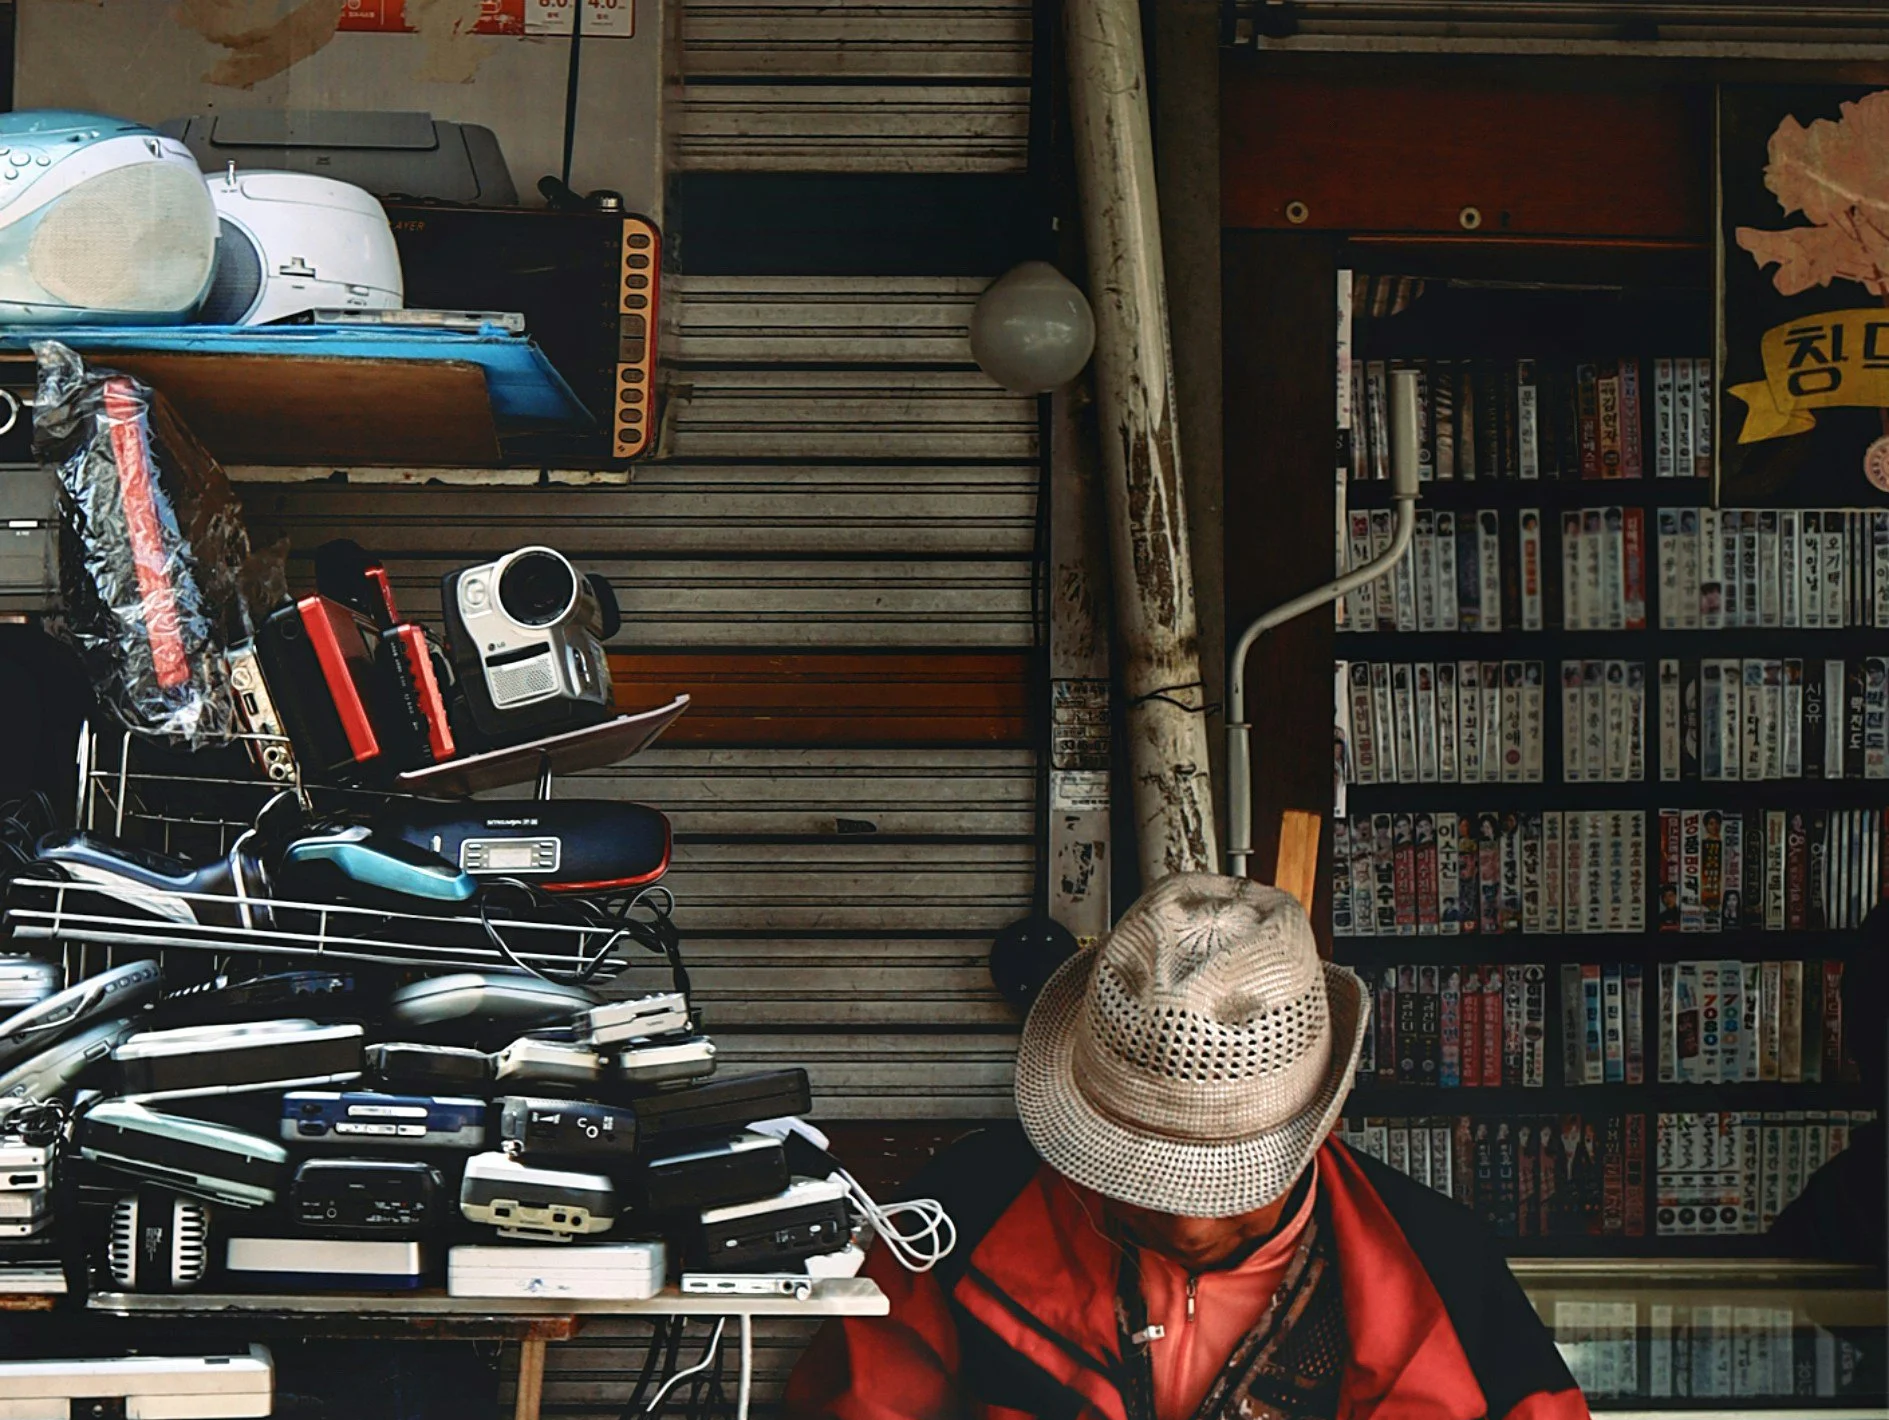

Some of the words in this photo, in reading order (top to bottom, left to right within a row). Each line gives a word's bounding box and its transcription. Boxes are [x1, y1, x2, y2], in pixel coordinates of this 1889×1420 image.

[1804, 682, 1822, 724] 신유
[1865, 690, 1884, 749] 박진도
[1438, 823, 1456, 880] 이수진
[1703, 994, 1718, 1046] 7080
[1722, 994, 1738, 1046] 7080
